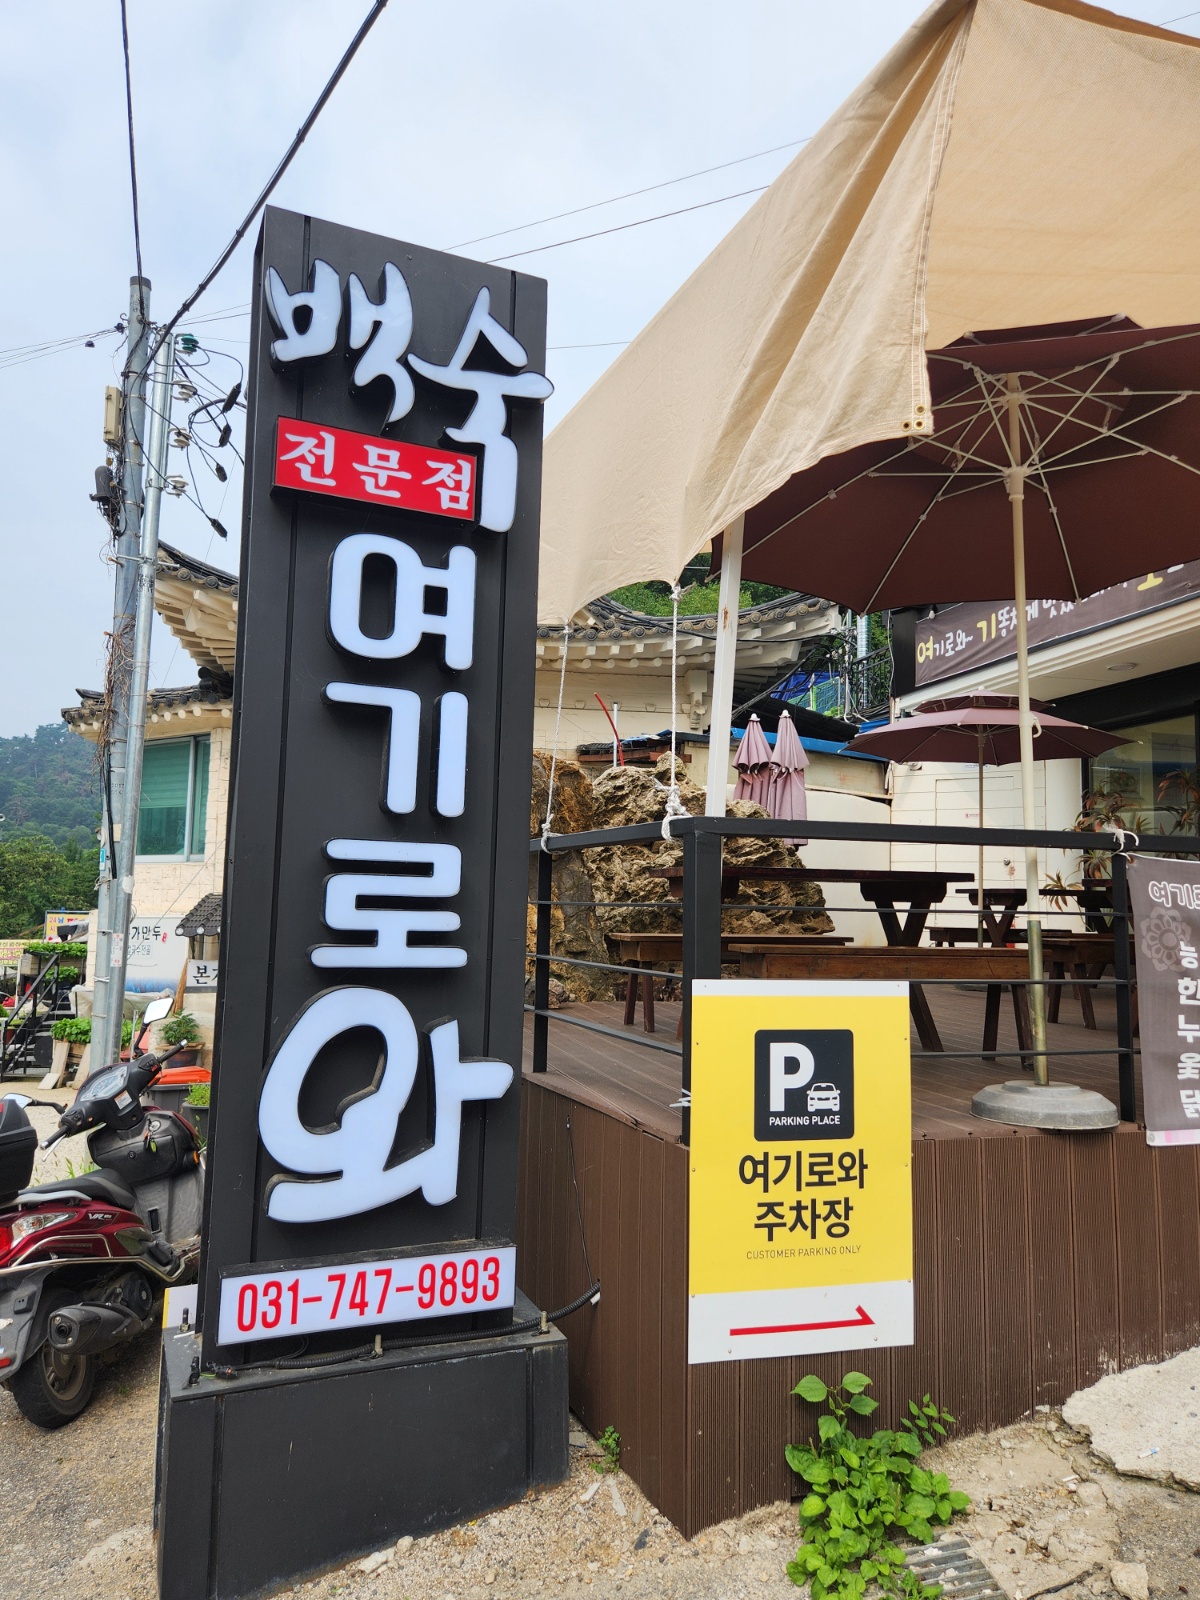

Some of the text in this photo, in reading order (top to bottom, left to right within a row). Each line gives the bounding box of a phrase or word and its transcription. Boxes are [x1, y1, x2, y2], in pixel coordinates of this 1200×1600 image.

[265, 258, 555, 532] 백숙
[280, 431, 472, 511] 전문점
[258, 532, 514, 1223] 여기로와
[128, 926, 161, 941] 가만두
[769, 1042, 815, 1112] P
[769, 1115, 841, 1126] PARKING PLACE
[739, 1148, 869, 1194] 여기로와
[754, 1196, 854, 1242] 주차장
[746, 1245, 861, 1260] CUSTOMER PARKING ONLY
[237, 1256, 501, 1333] 031-747-9893
